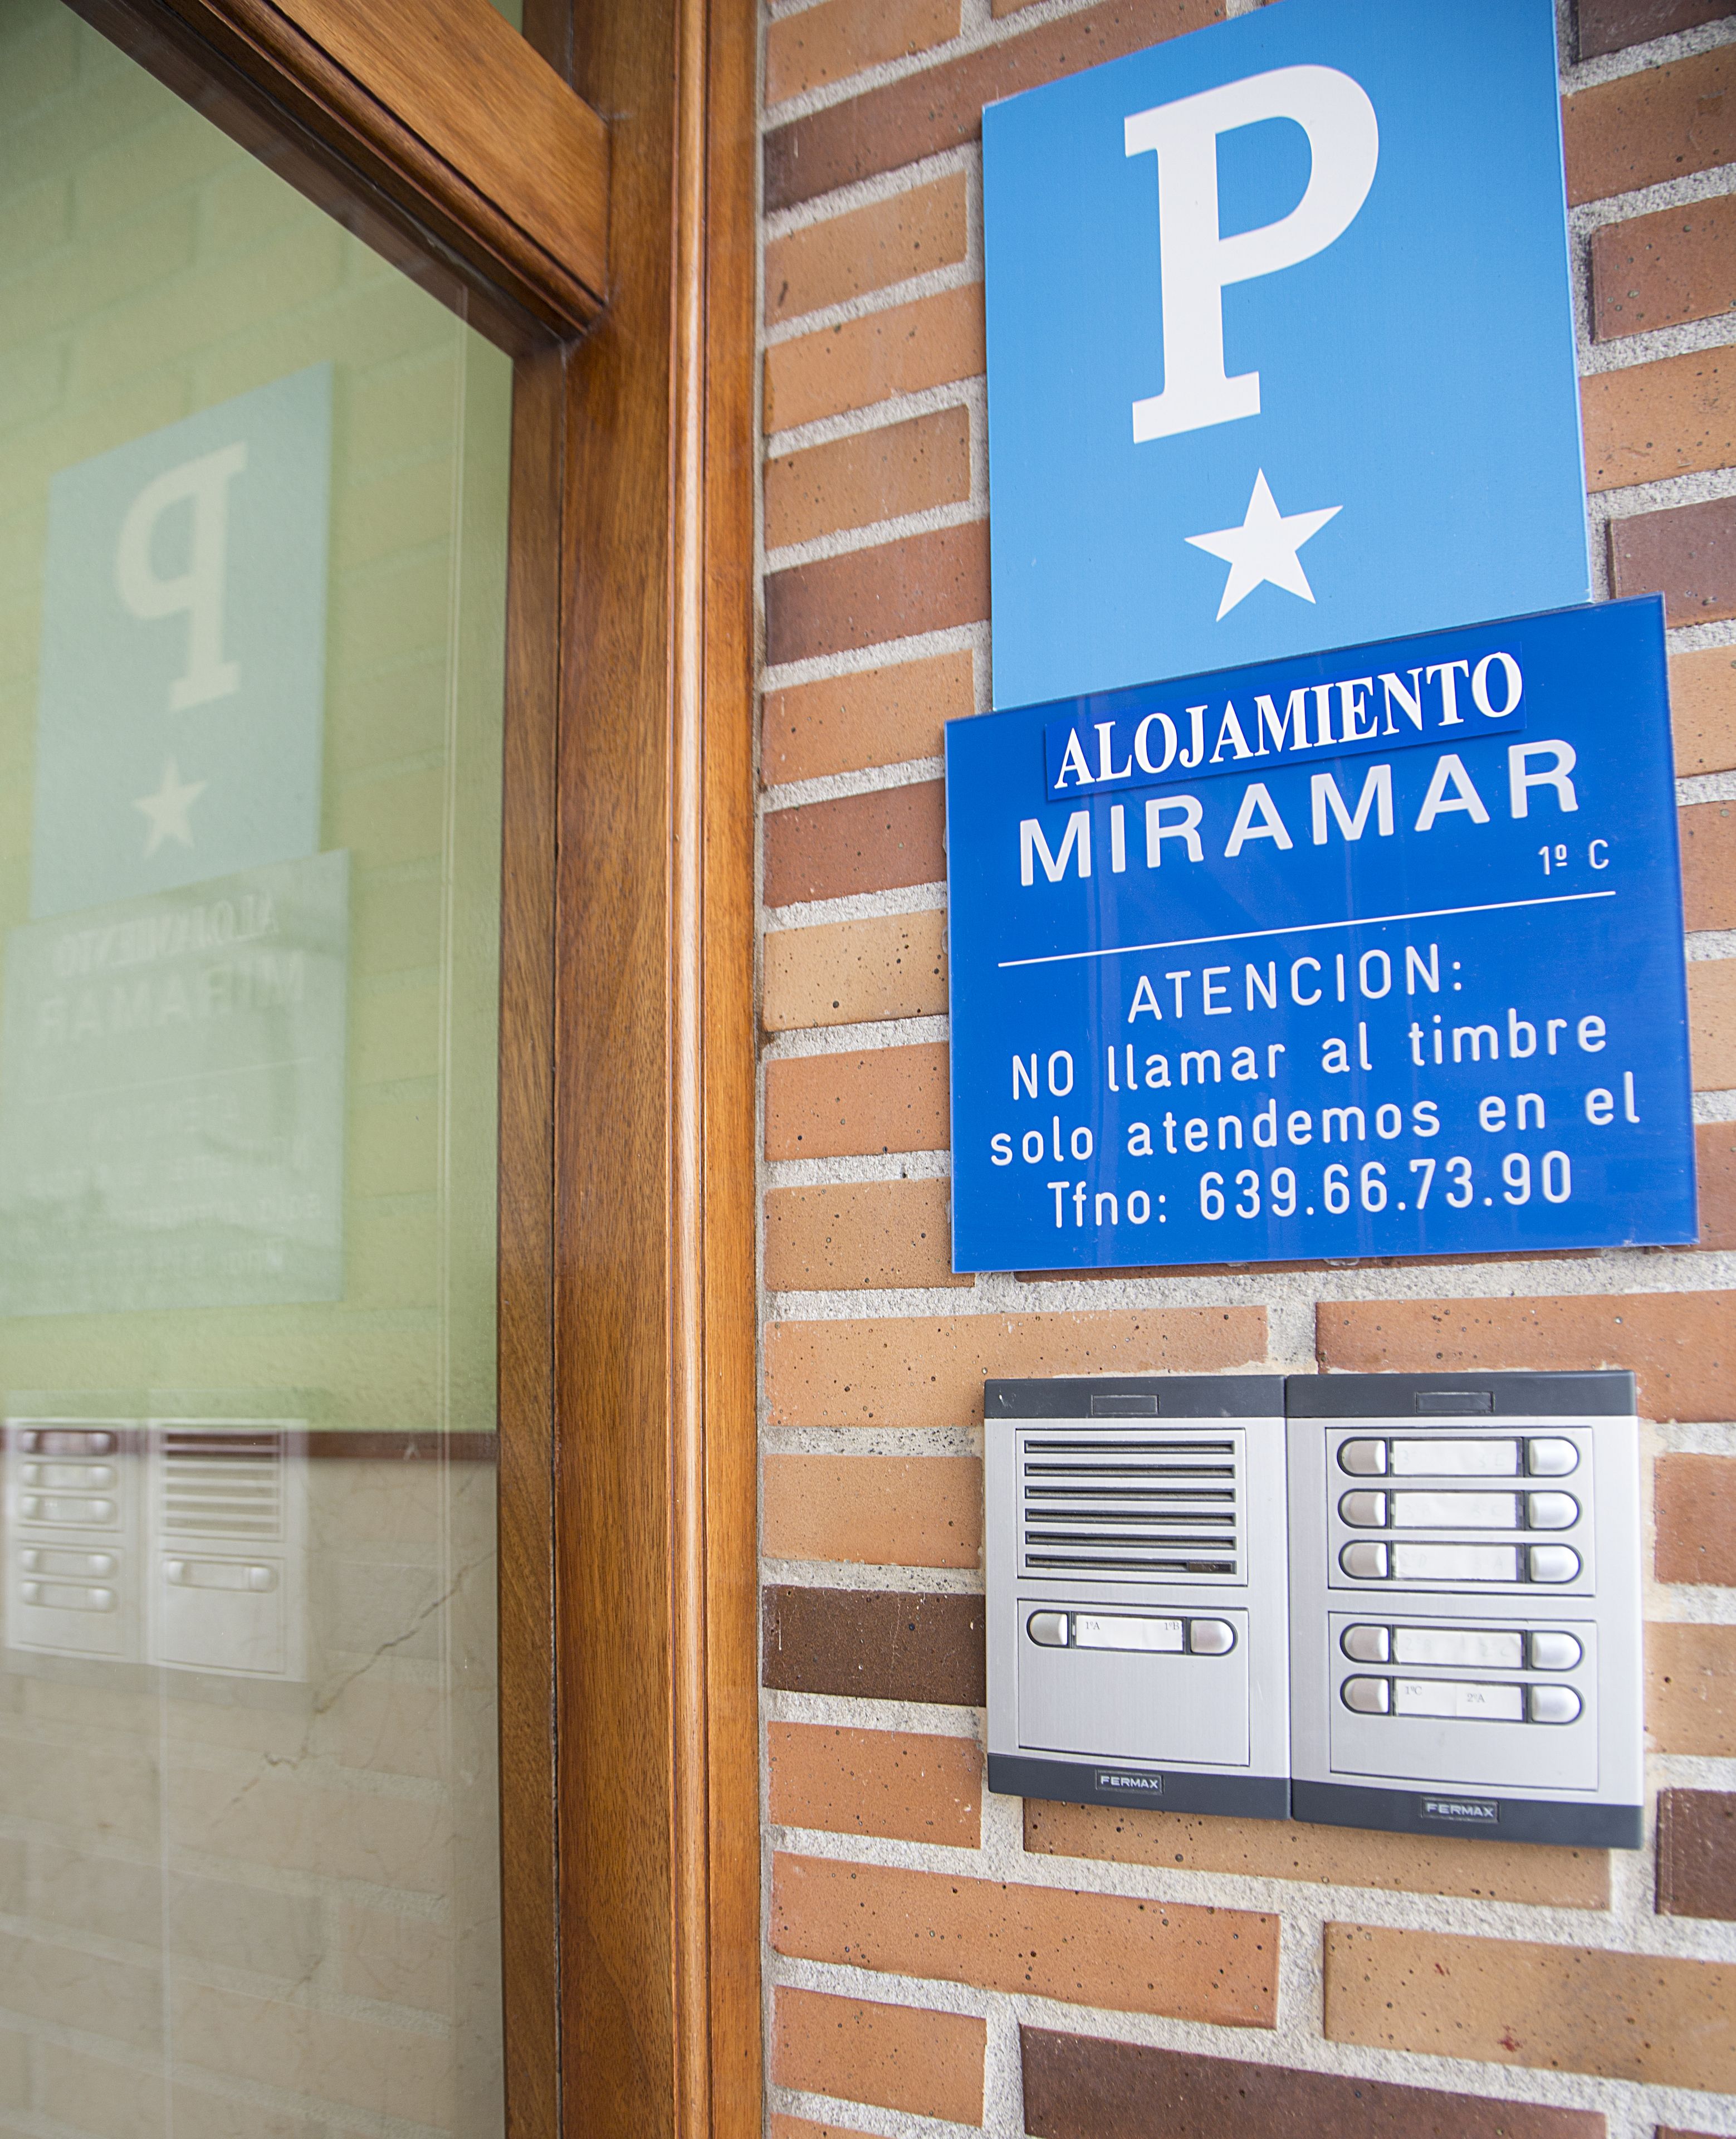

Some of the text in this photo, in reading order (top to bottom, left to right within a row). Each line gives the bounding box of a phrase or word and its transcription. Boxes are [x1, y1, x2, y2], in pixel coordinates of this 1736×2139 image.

[1124, 65, 1378, 444] P
[1054, 652, 1522, 788] ALOJAMIENTO
[1020, 740, 1578, 886] MIRAMAR
[1590, 839, 1608, 869] C
[1128, 944, 1461, 1023] ATENCION:
[1013, 1008, 1606, 1100] NO llamar al timbre
[991, 1071, 1640, 1165] solo atendemos en el
[1048, 1151, 1571, 1228] Tfno: 639.66.73.90
[1101, 1775, 1158, 1789] FERMAX
[1426, 1803, 1494, 1817] FERMAX
